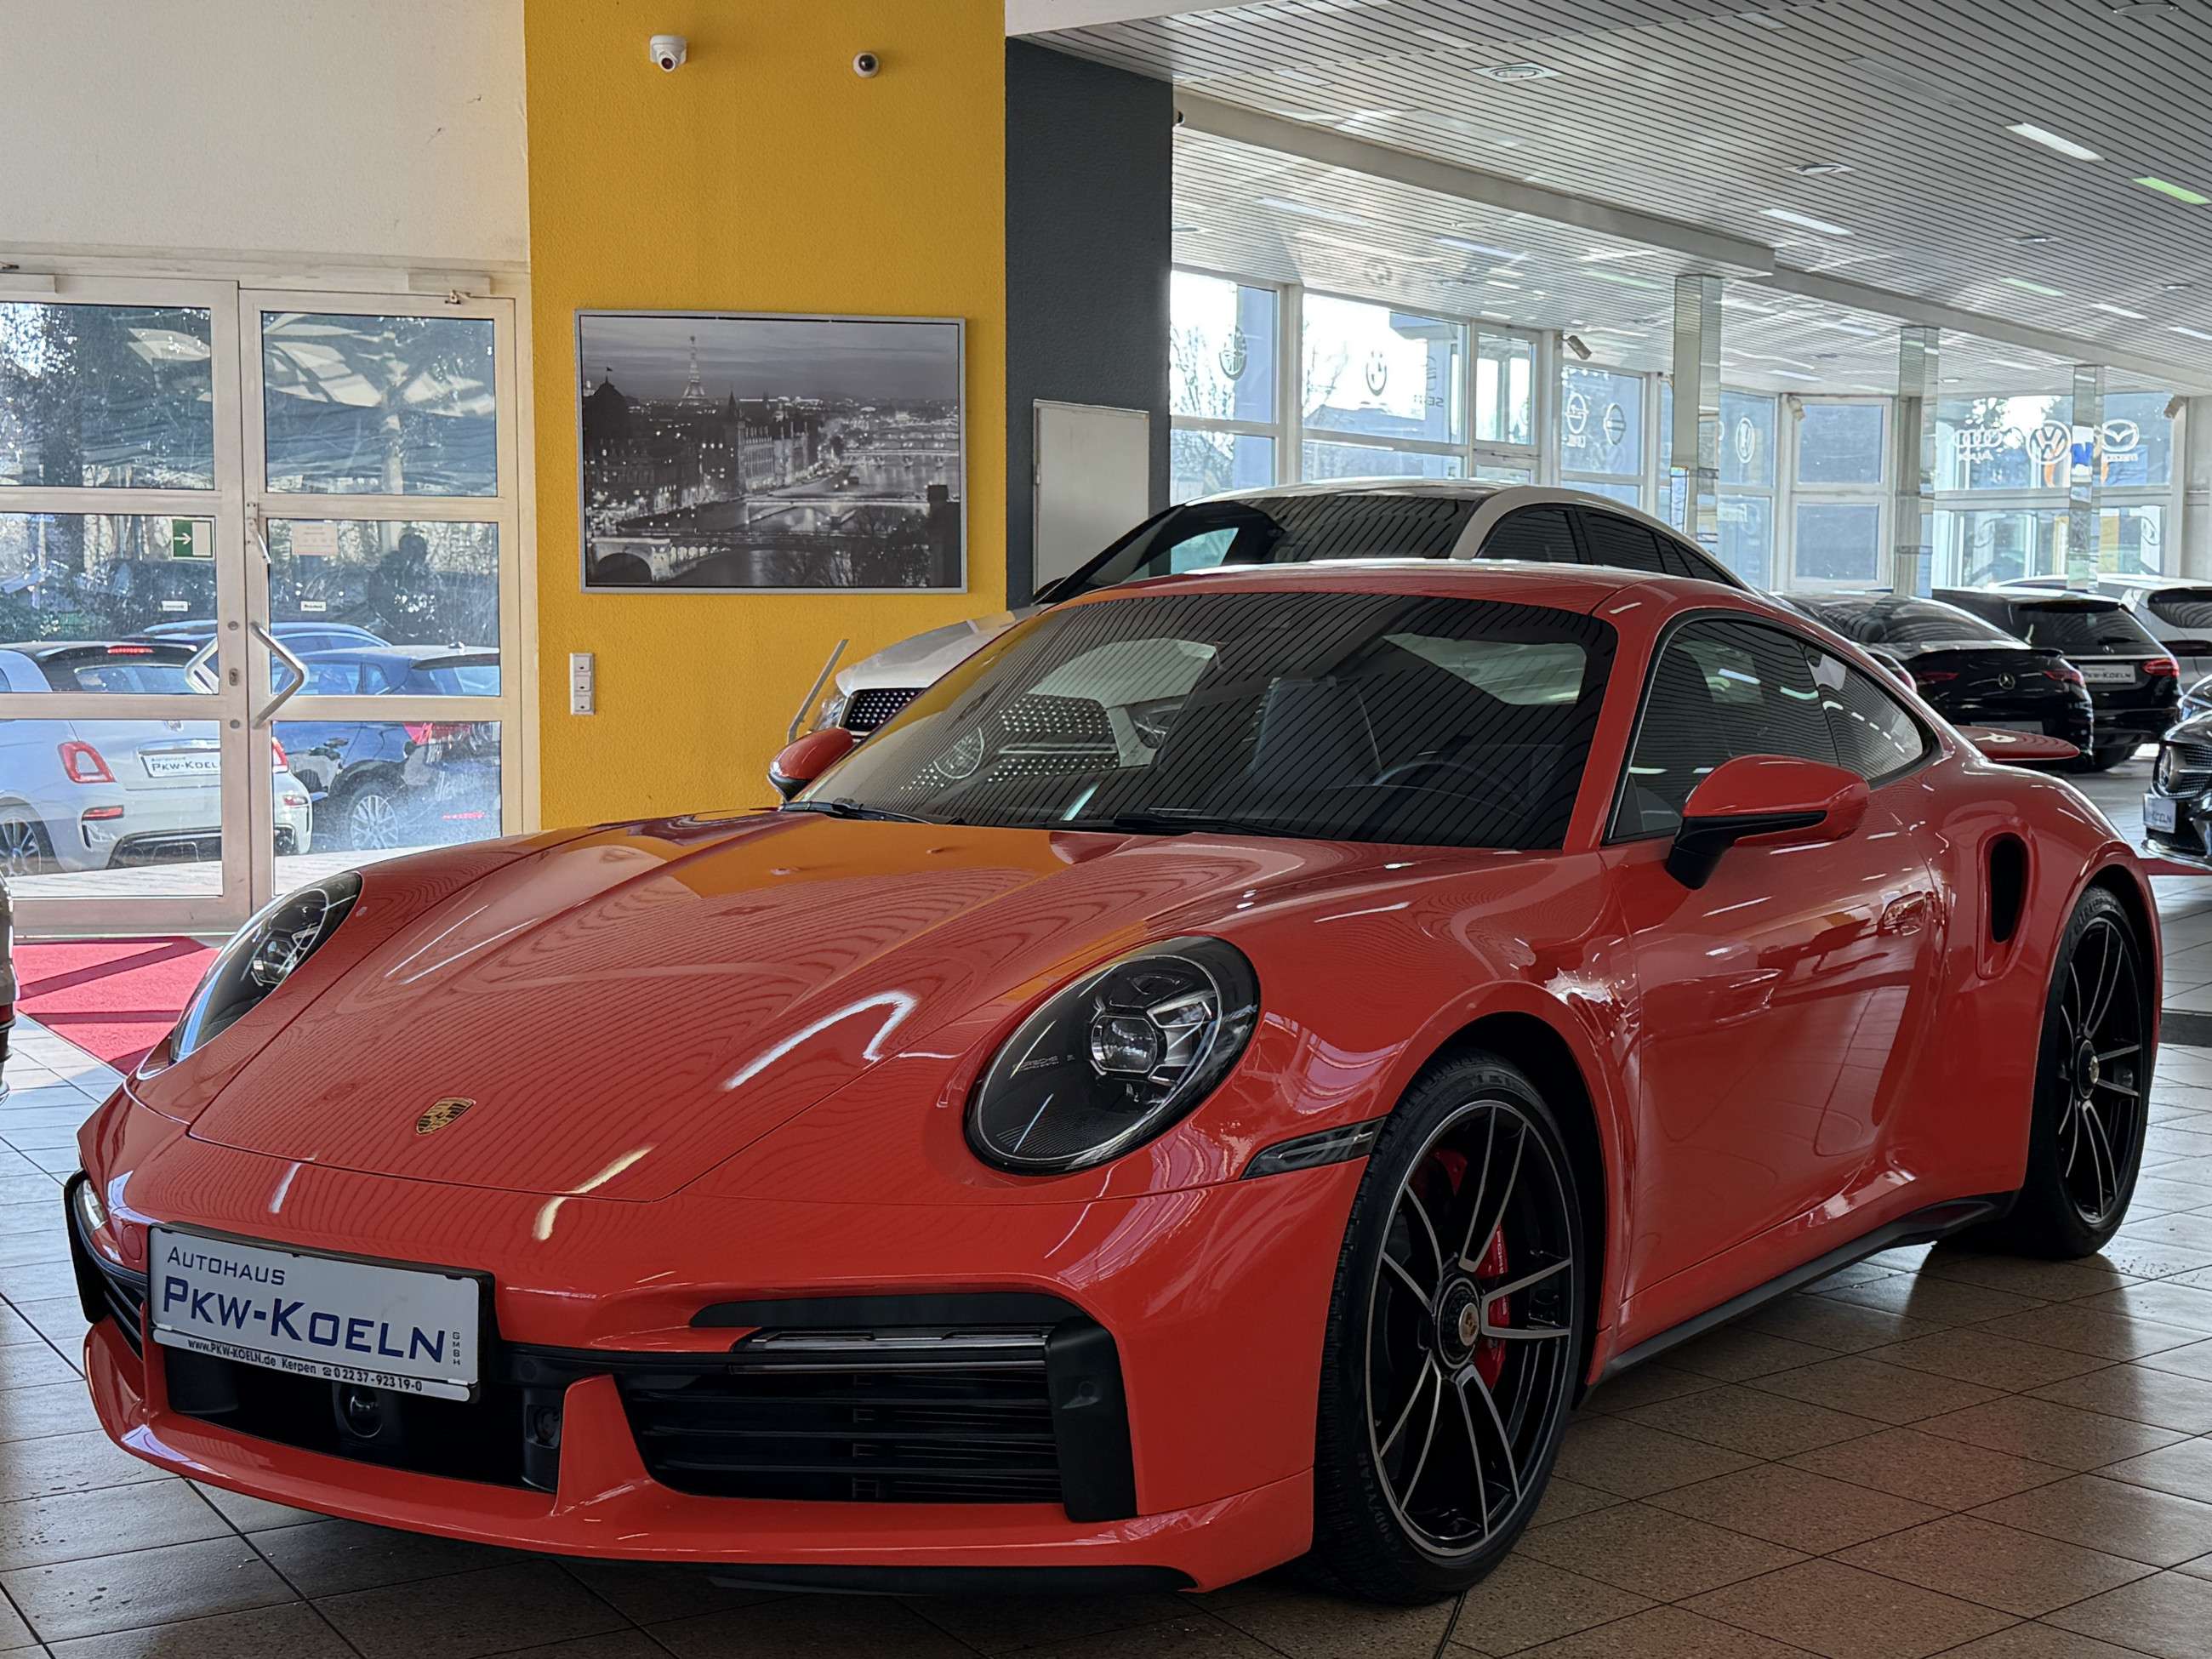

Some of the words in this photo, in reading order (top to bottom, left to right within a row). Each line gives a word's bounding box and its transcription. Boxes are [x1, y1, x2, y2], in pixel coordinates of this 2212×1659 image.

[151, 761, 219, 771] PKW-KOEL
[168, 1246, 286, 1286] AUTOHAUS
[162, 1275, 446, 1364] PKW-KOELN
[188, 1338, 277, 1366] www.PKW-KOELN.de
[282, 1351, 316, 1375] Kerpen
